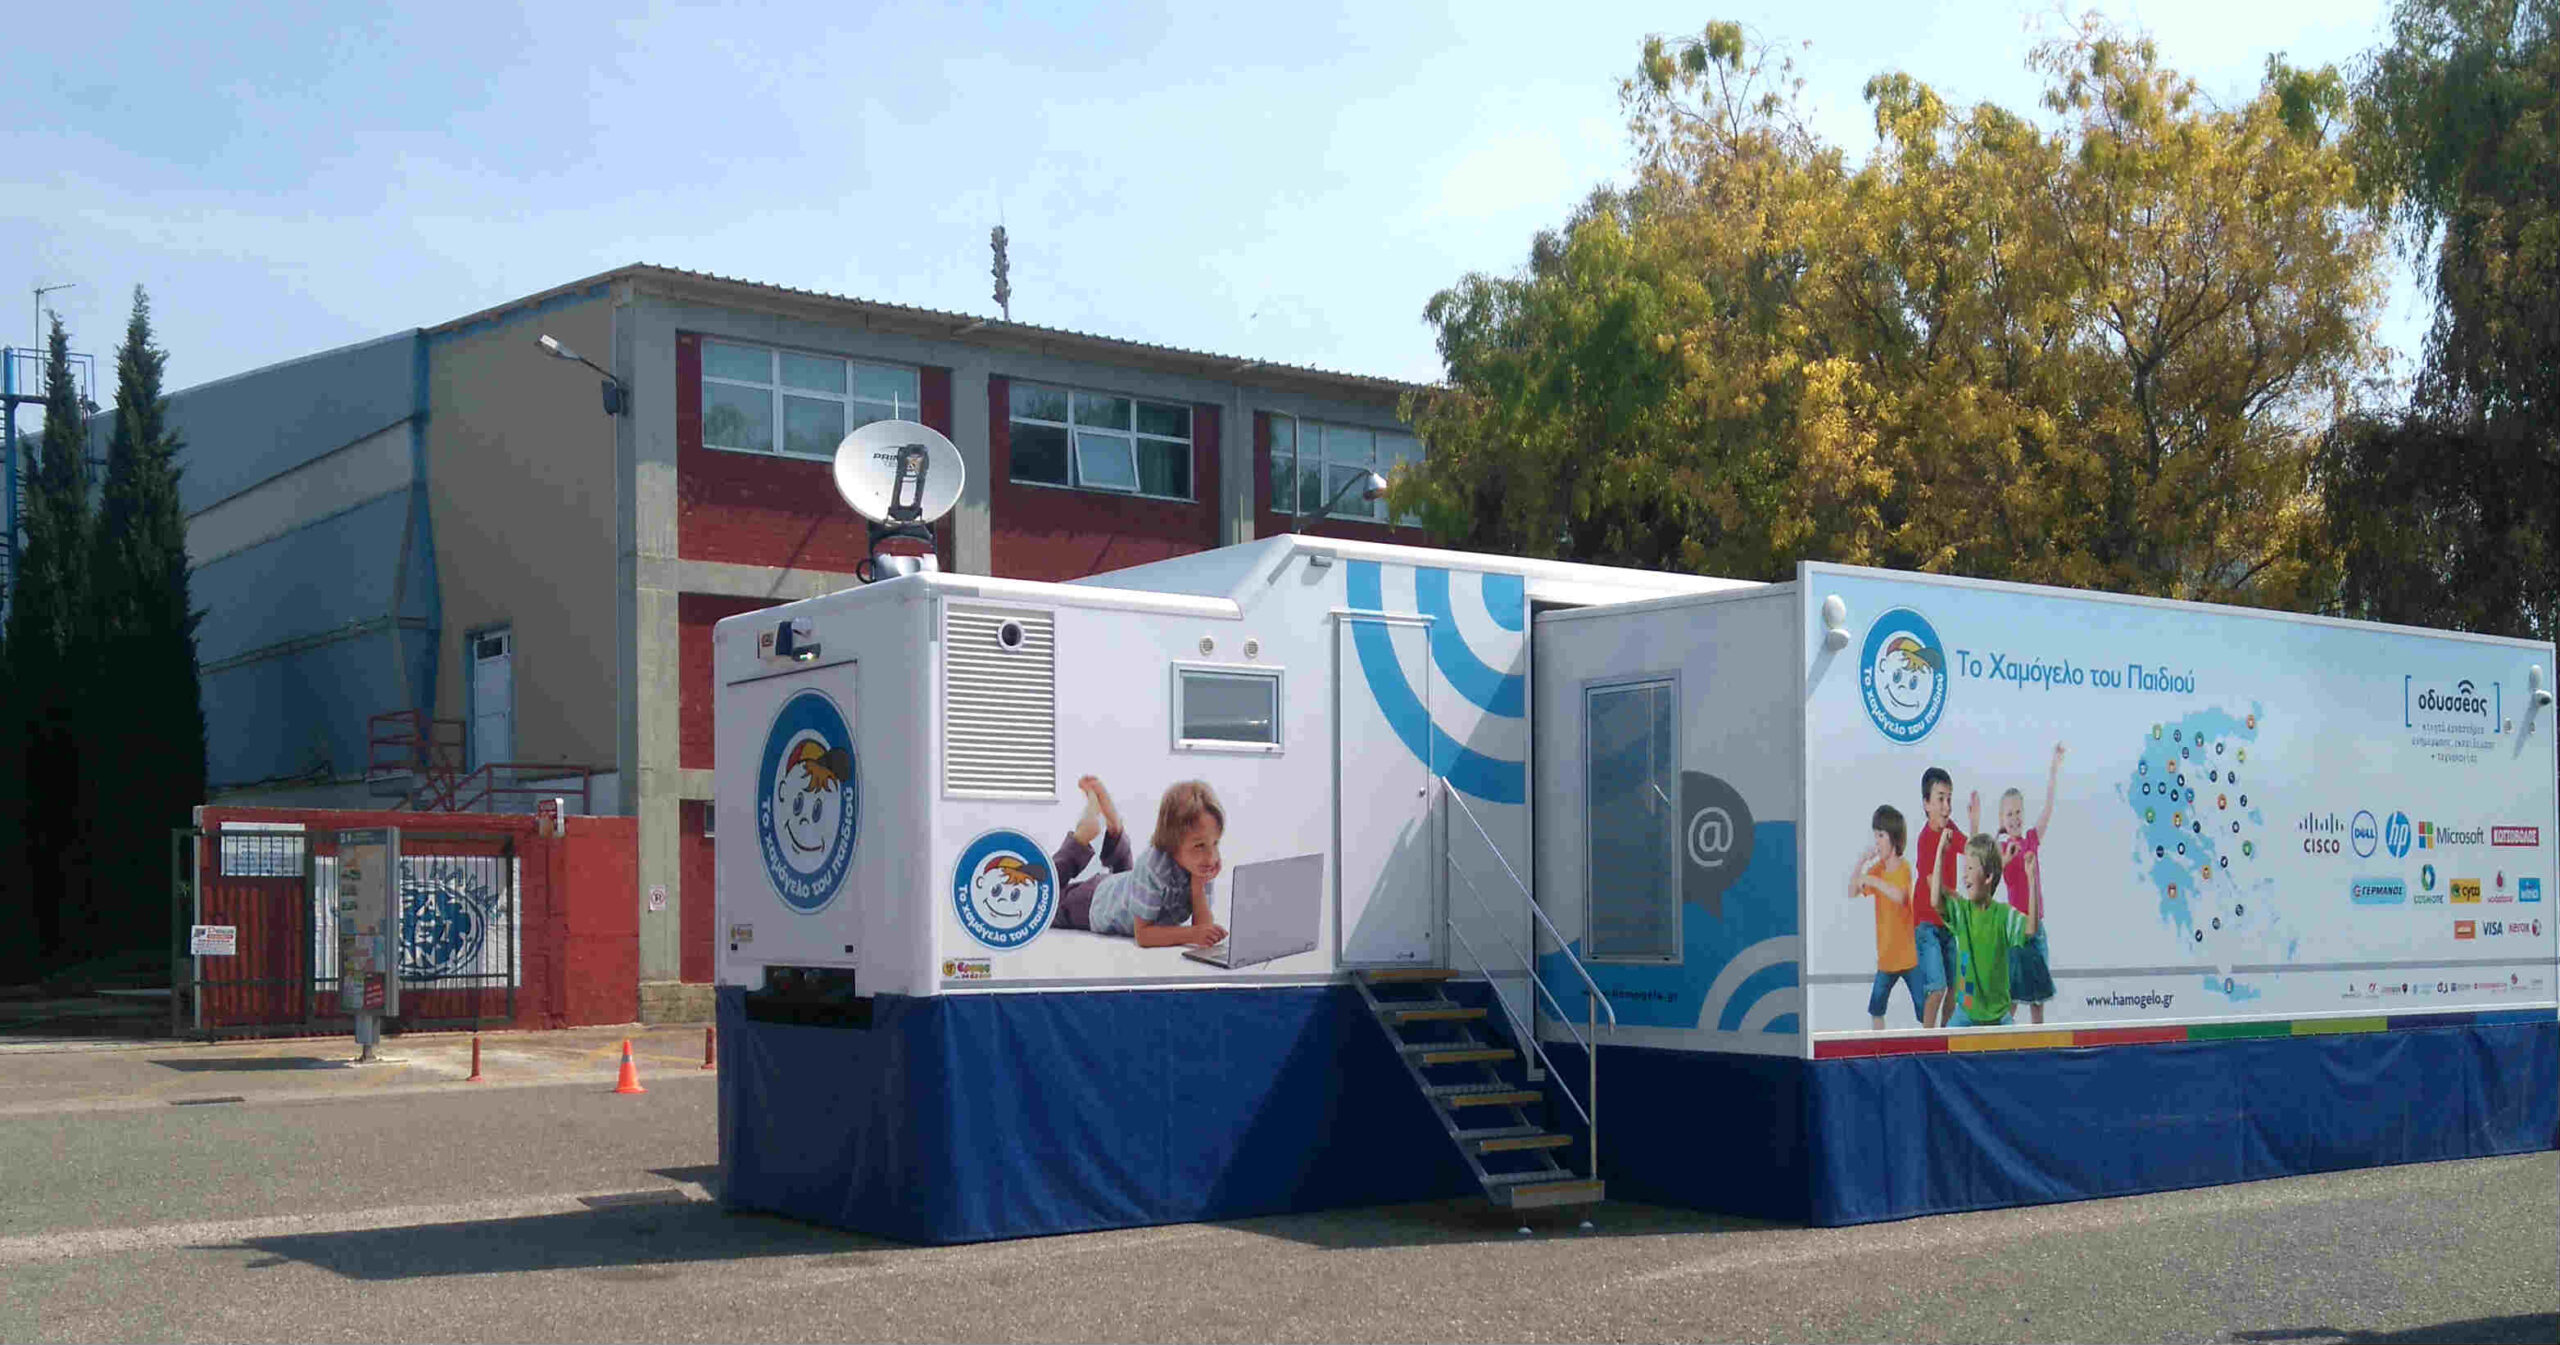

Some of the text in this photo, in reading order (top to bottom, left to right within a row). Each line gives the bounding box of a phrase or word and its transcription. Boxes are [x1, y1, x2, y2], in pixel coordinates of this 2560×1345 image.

[1956, 649, 2195, 693] Το Χαμόγελο του Παιδιού
[1864, 667, 1873, 687] Το
[1908, 722, 1925, 735] του
[761, 787, 853, 898] Το χαμόγελο του παιδιού
[2304, 838, 2340, 854] CISCO
[2354, 828, 2375, 839] DELL
[2388, 811, 2410, 858] hp
[2437, 826, 2484, 845] Microsoft
[958, 884, 1049, 942] Το χαμόγελο του παιδιού
[2483, 921, 2503, 935] VISA
[2086, 989, 2174, 1009] www.hamogelo.gr
